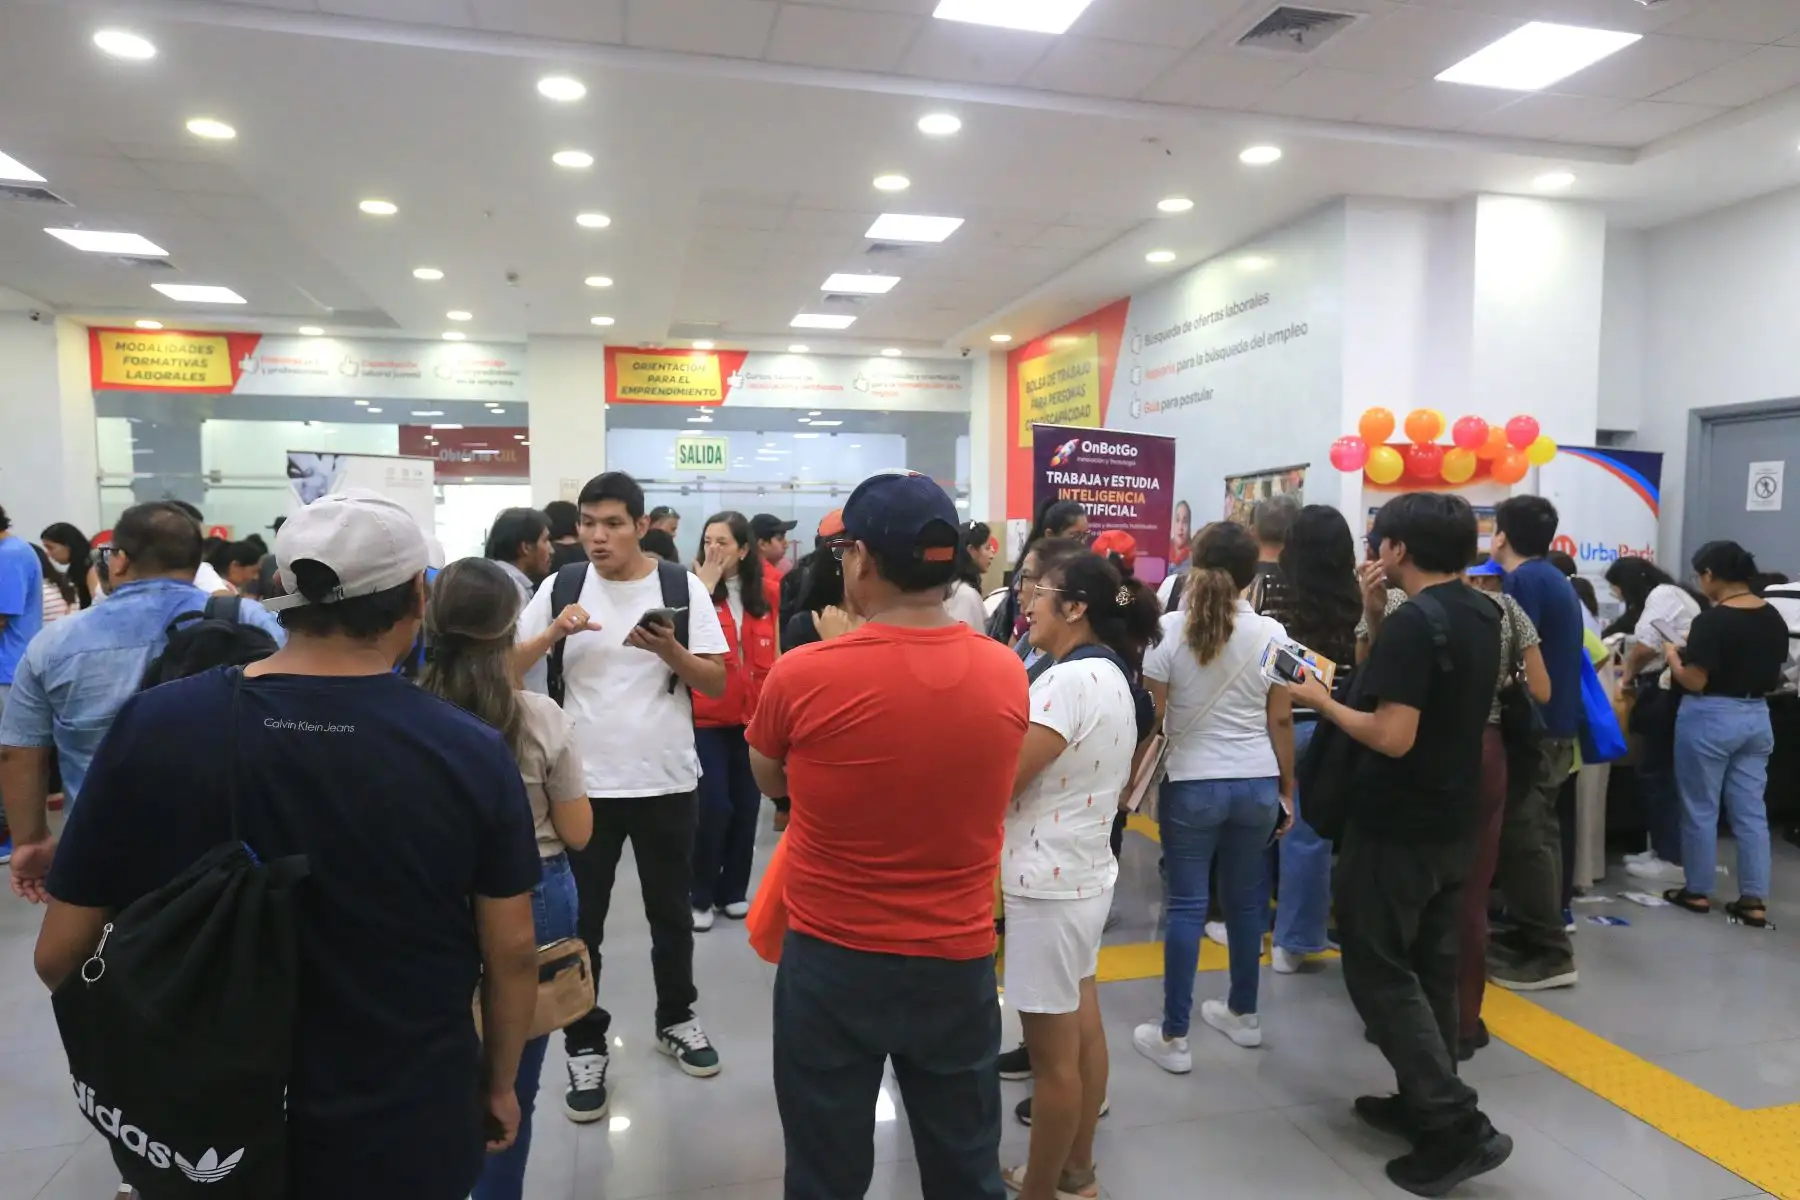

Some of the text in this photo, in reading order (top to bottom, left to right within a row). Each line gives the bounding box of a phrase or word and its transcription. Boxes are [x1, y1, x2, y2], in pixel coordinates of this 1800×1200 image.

[1182, 320, 1193, 334] de
[1193, 308, 1224, 329] ofertas
[1225, 291, 1270, 318] laborales
[115, 341, 215, 355] MODALIDADES
[1176, 357, 1195, 375] para
[1195, 352, 1204, 366] la
[1250, 331, 1266, 351] del
[1267, 321, 1308, 346] empleo
[122, 355, 209, 368] FORMATIVAS
[632, 361, 706, 373] ORIENTACIÓN
[125, 369, 206, 382] LABORALES
[648, 374, 690, 384] PARA EL
[1025, 361, 1092, 394] BOLSA DE TRABAJO
[621, 386, 717, 397] EMPRENDIMIENTO
[1048, 383, 1086, 405] PERSONAS
[1160, 394, 1179, 414] para
[1179, 386, 1214, 409] postular
[680, 444, 723, 465] SALIDA
[1081, 440, 1138, 457] OnBotGo
[1046, 471, 1160, 490] TRABAJA Y ESTUDIA
[1058, 487, 1146, 504] INTELIGENCIA
[1078, 502, 1138, 518] TIFICIAL
[263, 717, 355, 733] Calvin Klein Jeans
[70, 1073, 172, 1169] didas
